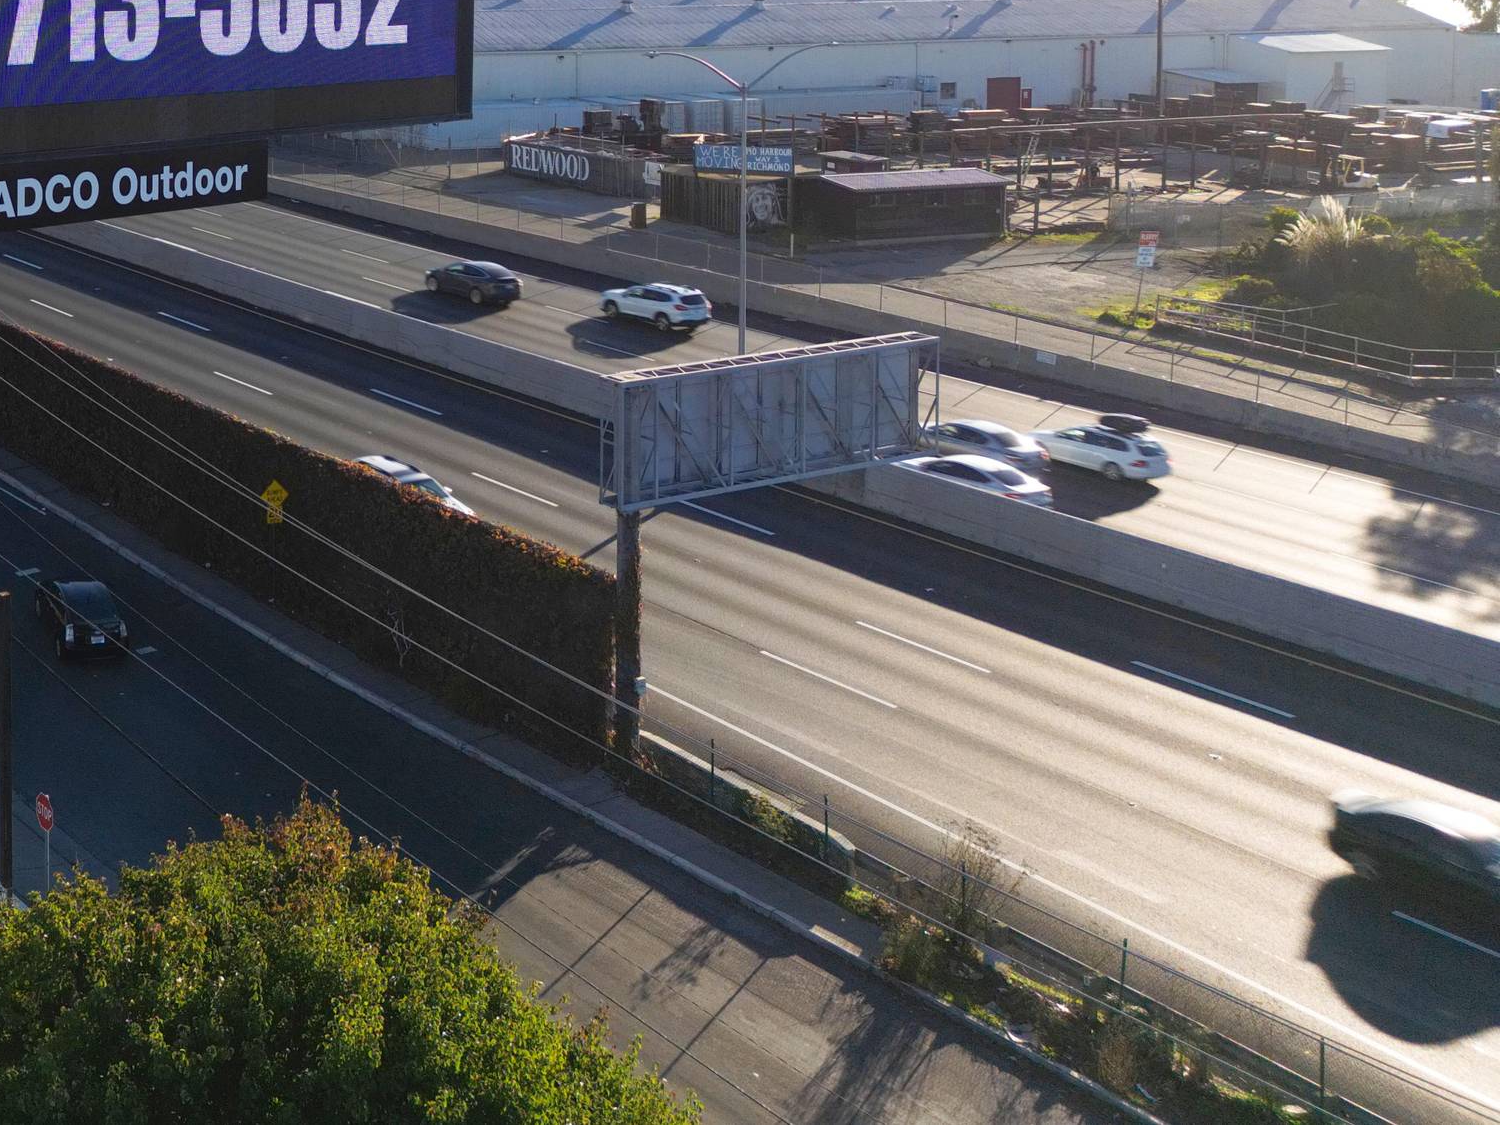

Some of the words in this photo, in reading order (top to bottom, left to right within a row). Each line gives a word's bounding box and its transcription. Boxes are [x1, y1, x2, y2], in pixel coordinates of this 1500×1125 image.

[511, 144, 589, 181] REDWOOD
[696, 156, 742, 169] MOVING
[747, 162, 790, 172] RICHMOND
[112, 161, 249, 204] Outdoor
[37, 801, 52, 821] STOP
